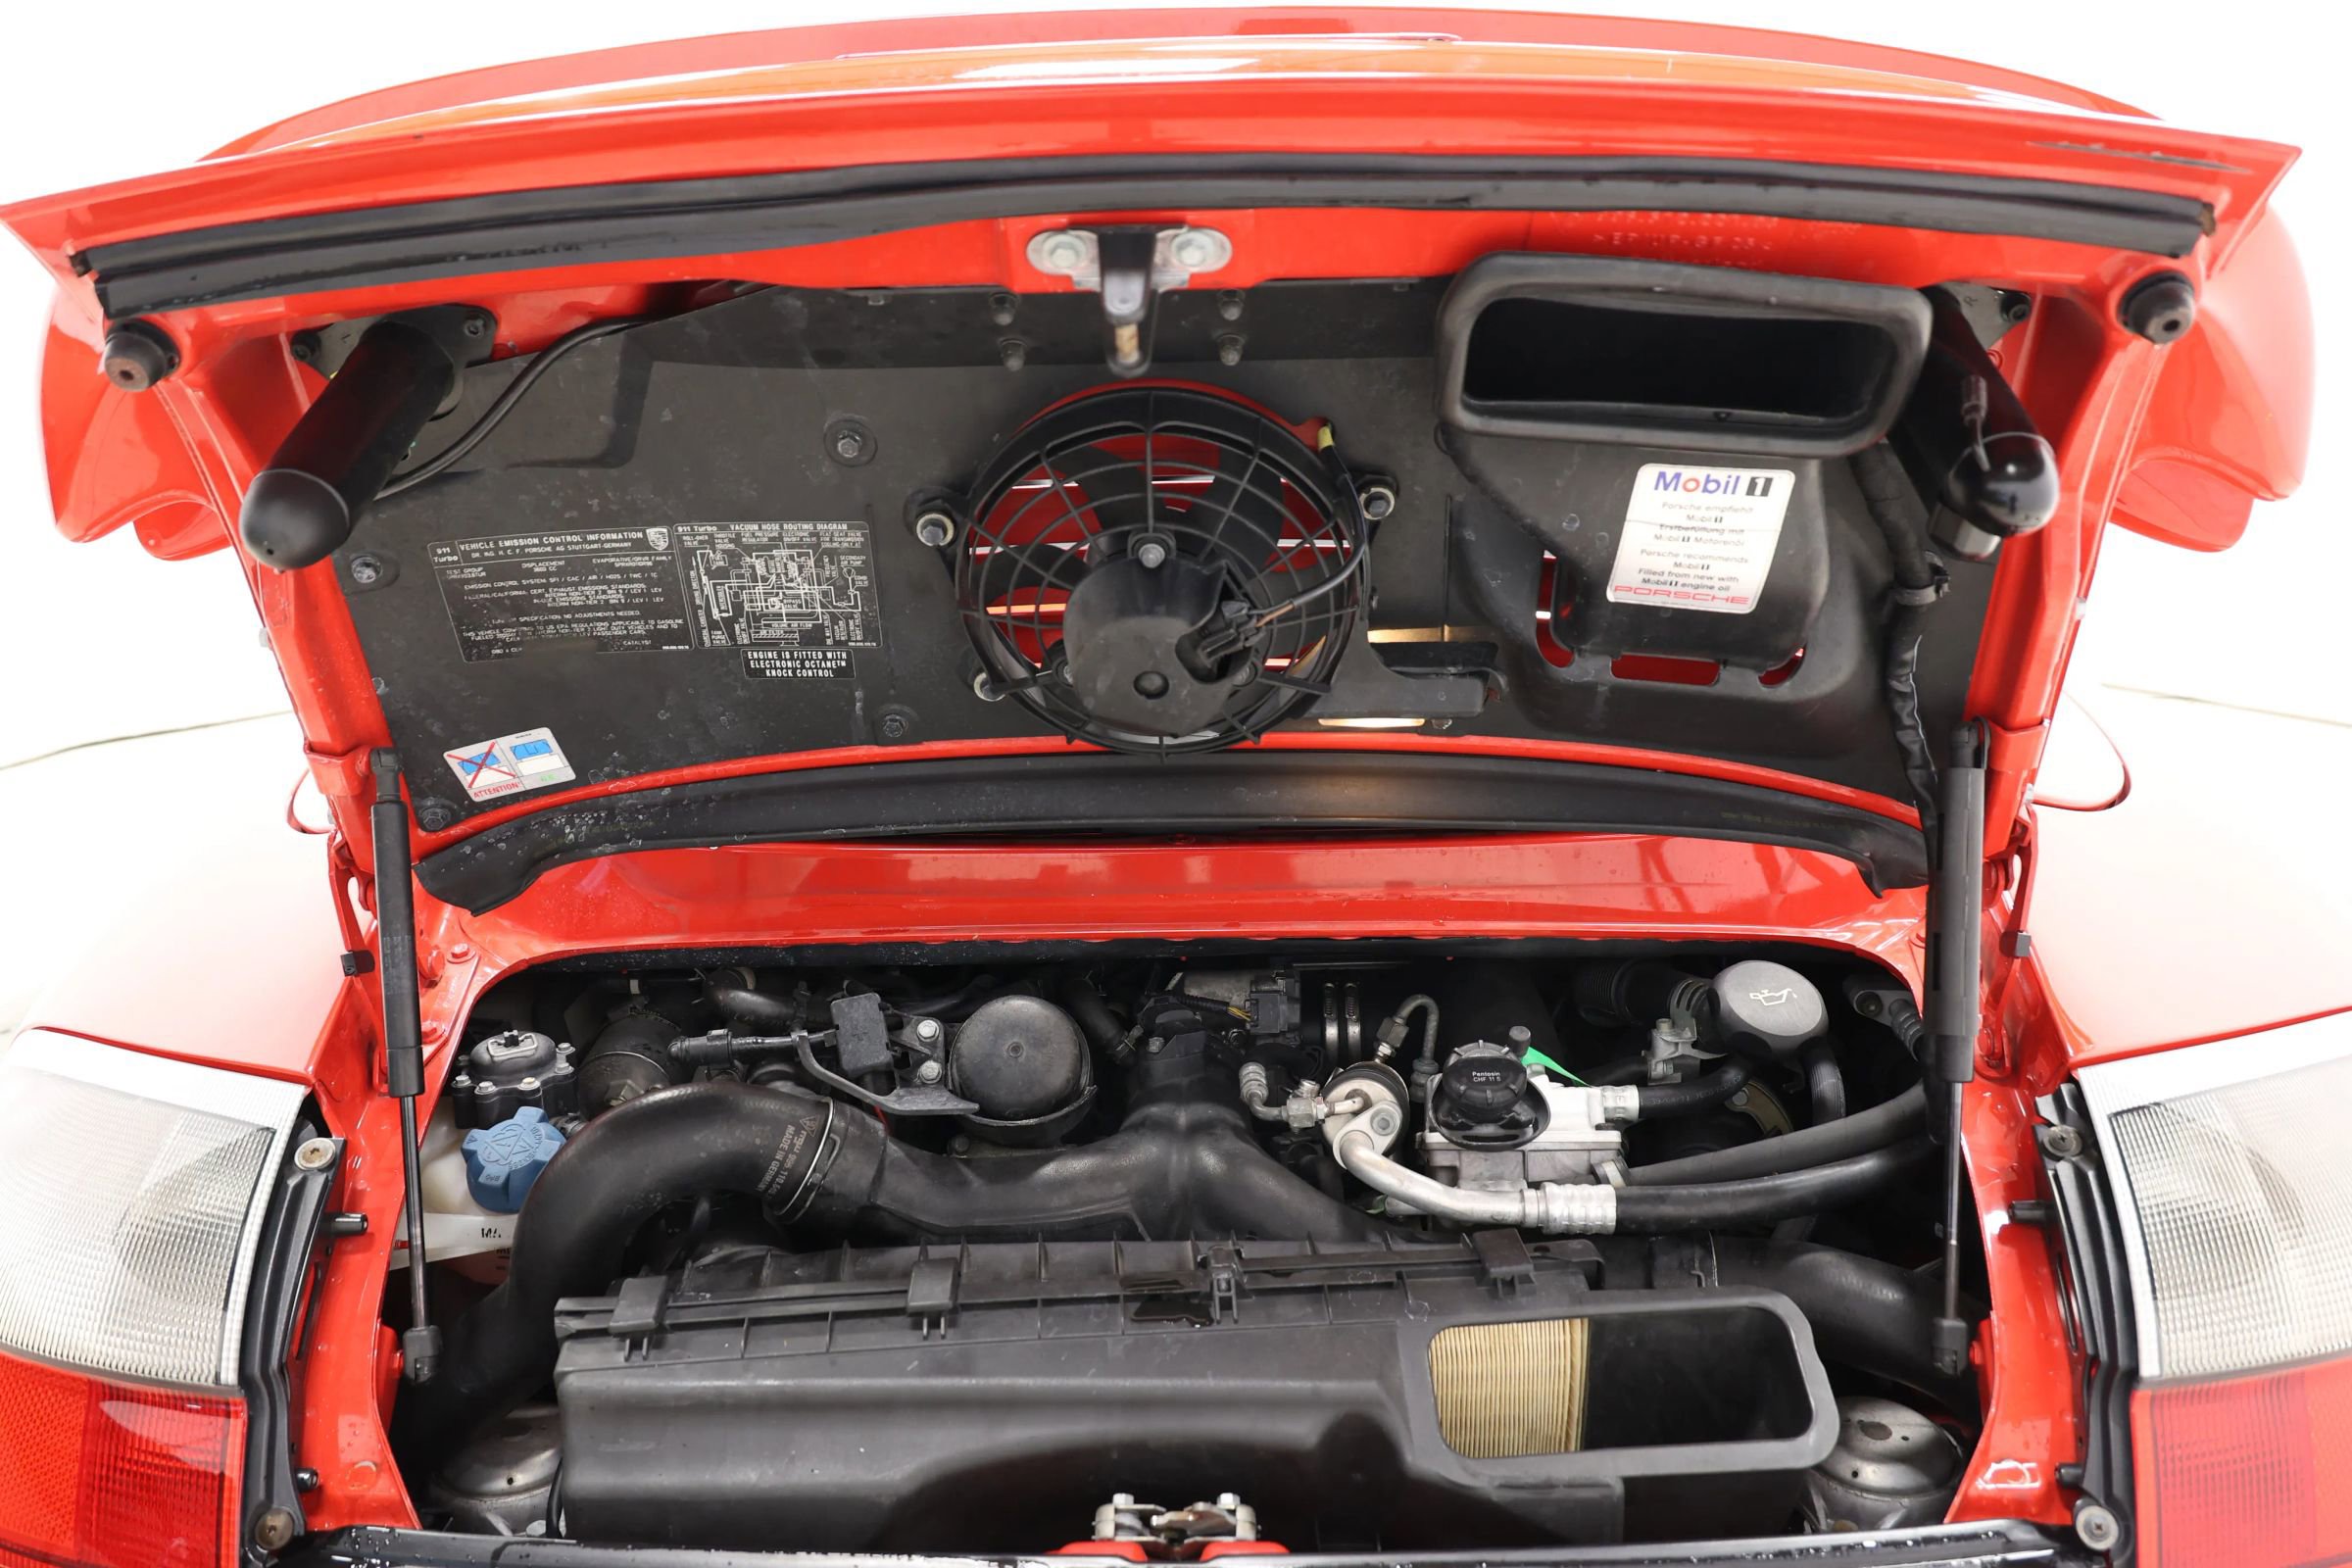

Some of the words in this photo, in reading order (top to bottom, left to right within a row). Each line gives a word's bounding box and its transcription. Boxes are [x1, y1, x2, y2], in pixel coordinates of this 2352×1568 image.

[1654, 471, 1740, 495] Mobil
[1745, 476, 1774, 497] 1
[1662, 502, 1701, 511] Porsche
[459, 541, 495, 551] VEHICLE
[499, 538, 540, 548] EMISSION
[543, 534, 582, 544] CONTROL
[586, 531, 643, 541] INFORMATION
[566, 542, 632, 551] STUTTGART-GERMANY
[1641, 549, 1680, 558] Porsche
[1683, 553, 1748, 564] recommends
[1667, 569, 1690, 578] from
[1642, 577, 1668, 586] Mobil
[1681, 582, 1715, 591] engine
[1614, 585, 1750, 605] PORSCHE
[750, 660, 802, 668] ELECTRONIC
[765, 668, 794, 677] KNOCK
[796, 668, 835, 677] CONTROL
[779, 1124, 796, 1151] MADE
[775, 1150, 787, 1161] IN
[756, 1160, 781, 1192] GERMANY
